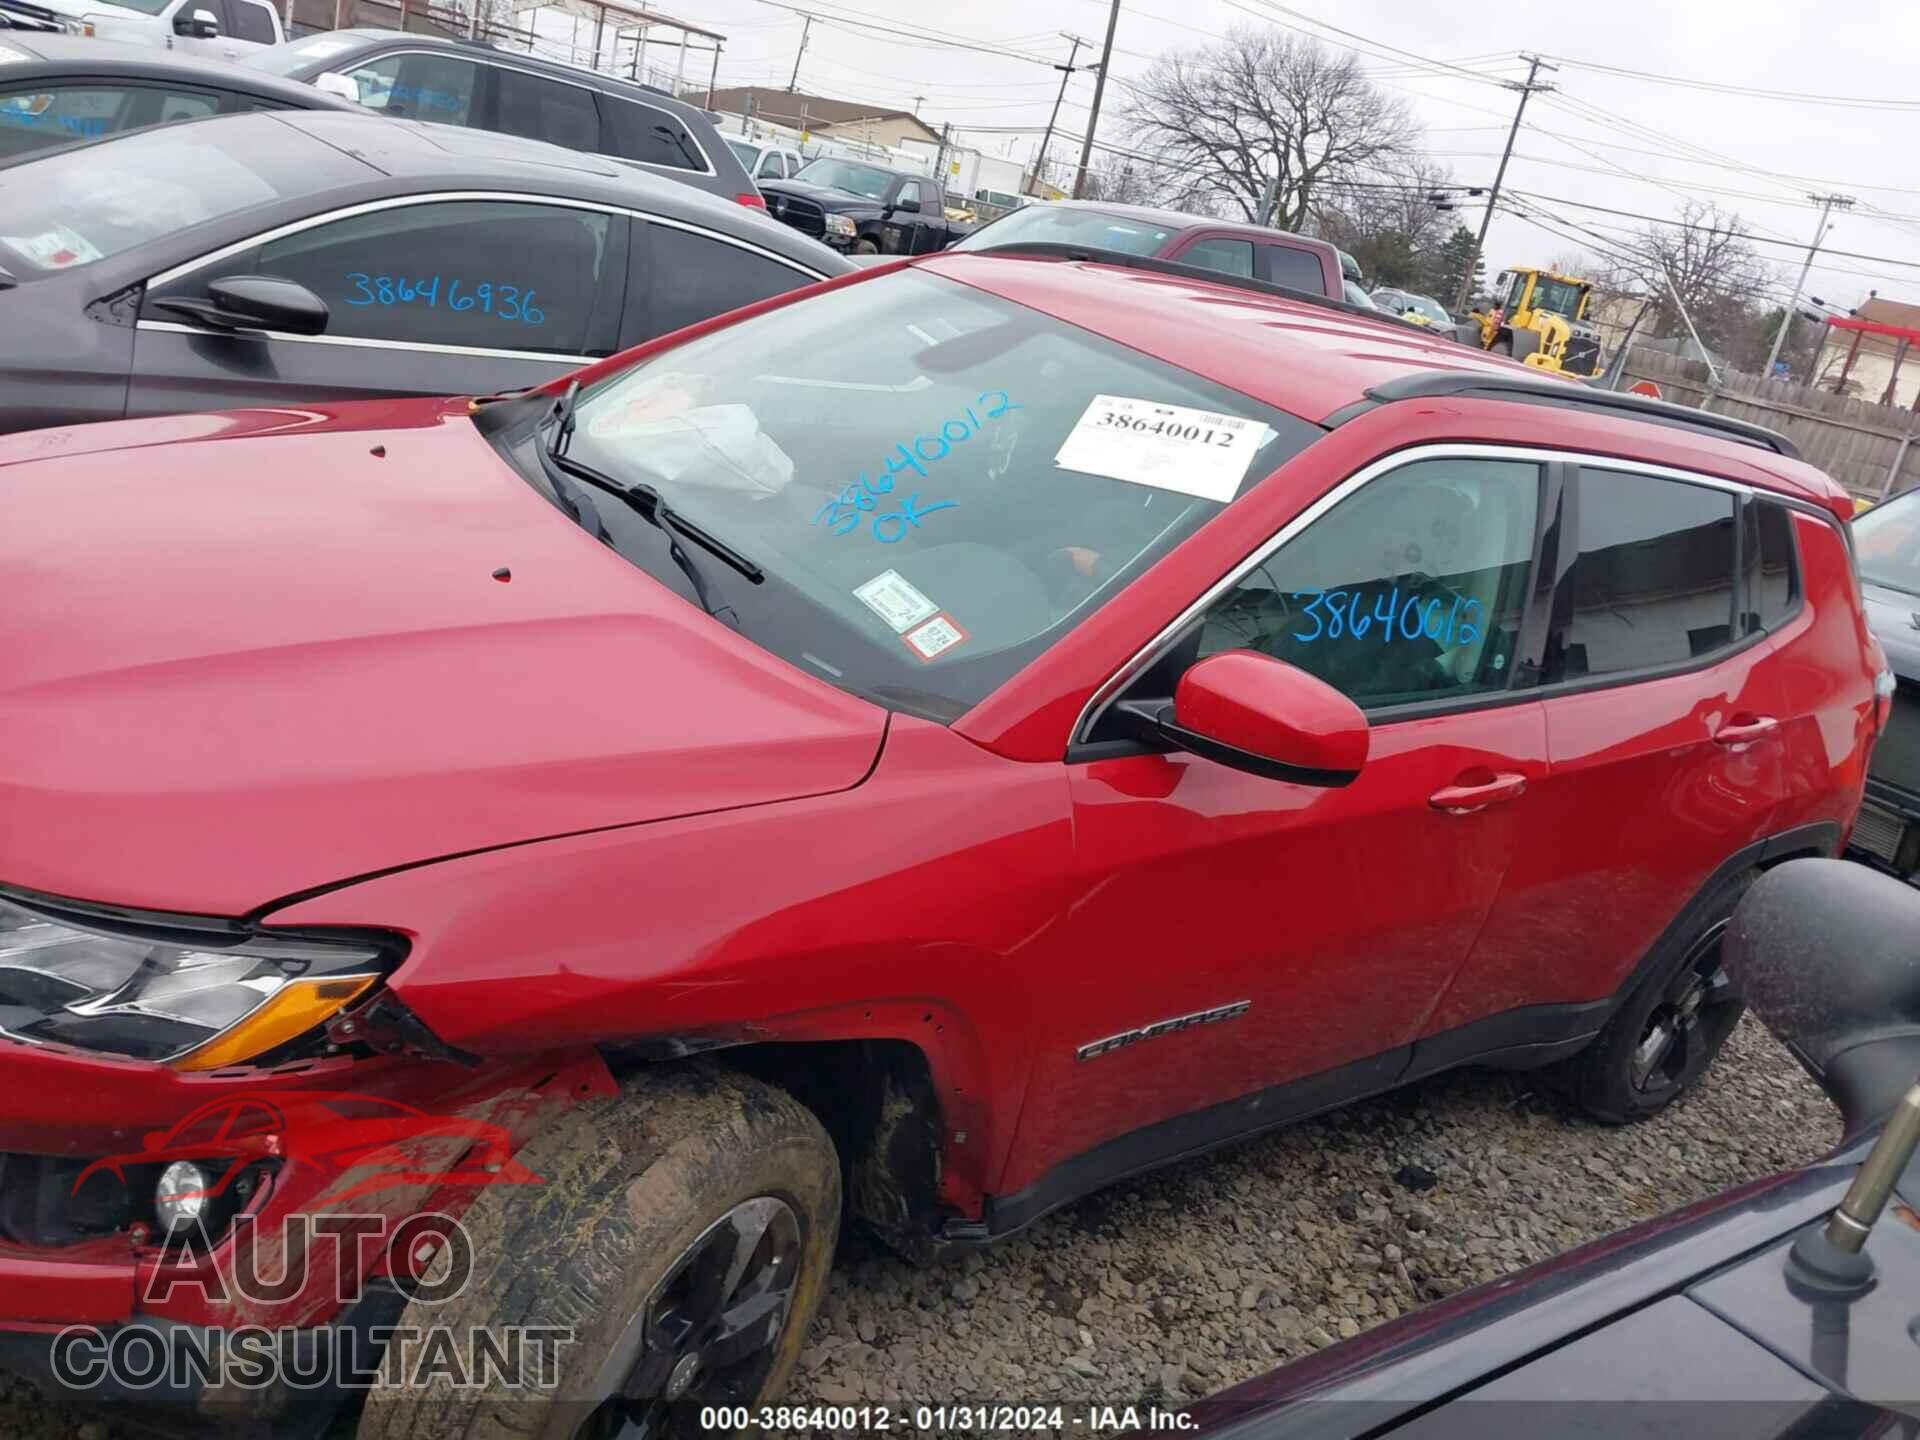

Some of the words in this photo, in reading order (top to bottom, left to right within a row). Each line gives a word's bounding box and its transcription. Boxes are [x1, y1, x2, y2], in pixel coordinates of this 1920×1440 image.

[343, 272, 545, 326] 38646936
[1096, 411, 1235, 448] 38640012
[871, 491, 960, 543] OK
